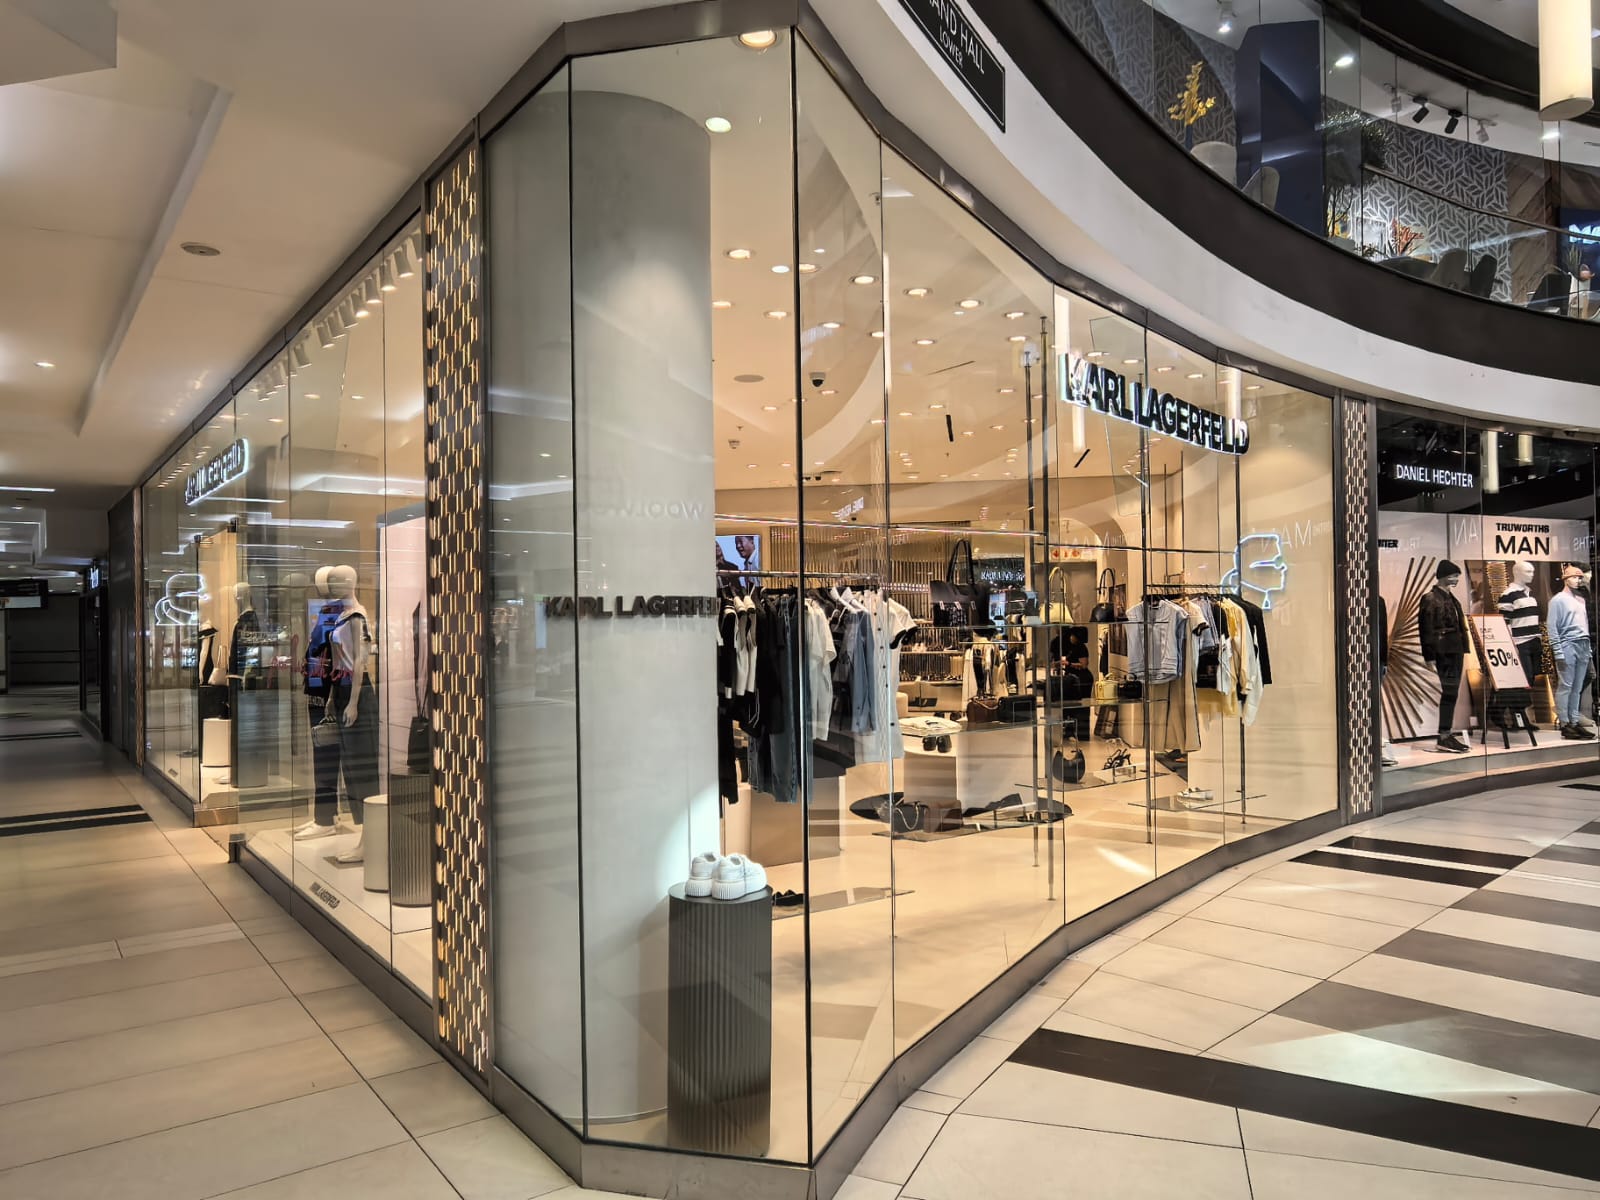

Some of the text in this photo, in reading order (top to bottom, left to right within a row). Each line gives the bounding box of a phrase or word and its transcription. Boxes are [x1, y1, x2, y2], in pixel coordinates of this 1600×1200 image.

[929, 0, 985, 75] AND HALL
[939, 24, 964, 69] LOWER
[1059, 352, 1250, 455] KARL LAGERFELD
[1396, 464, 1474, 489] DANIEL HECHTER
[1495, 522, 1550, 534] TRUWORTHS
[1495, 534, 1550, 556] MAN
[544, 596, 613, 619] KARL
[1486, 648, 1519, 667] 50%
